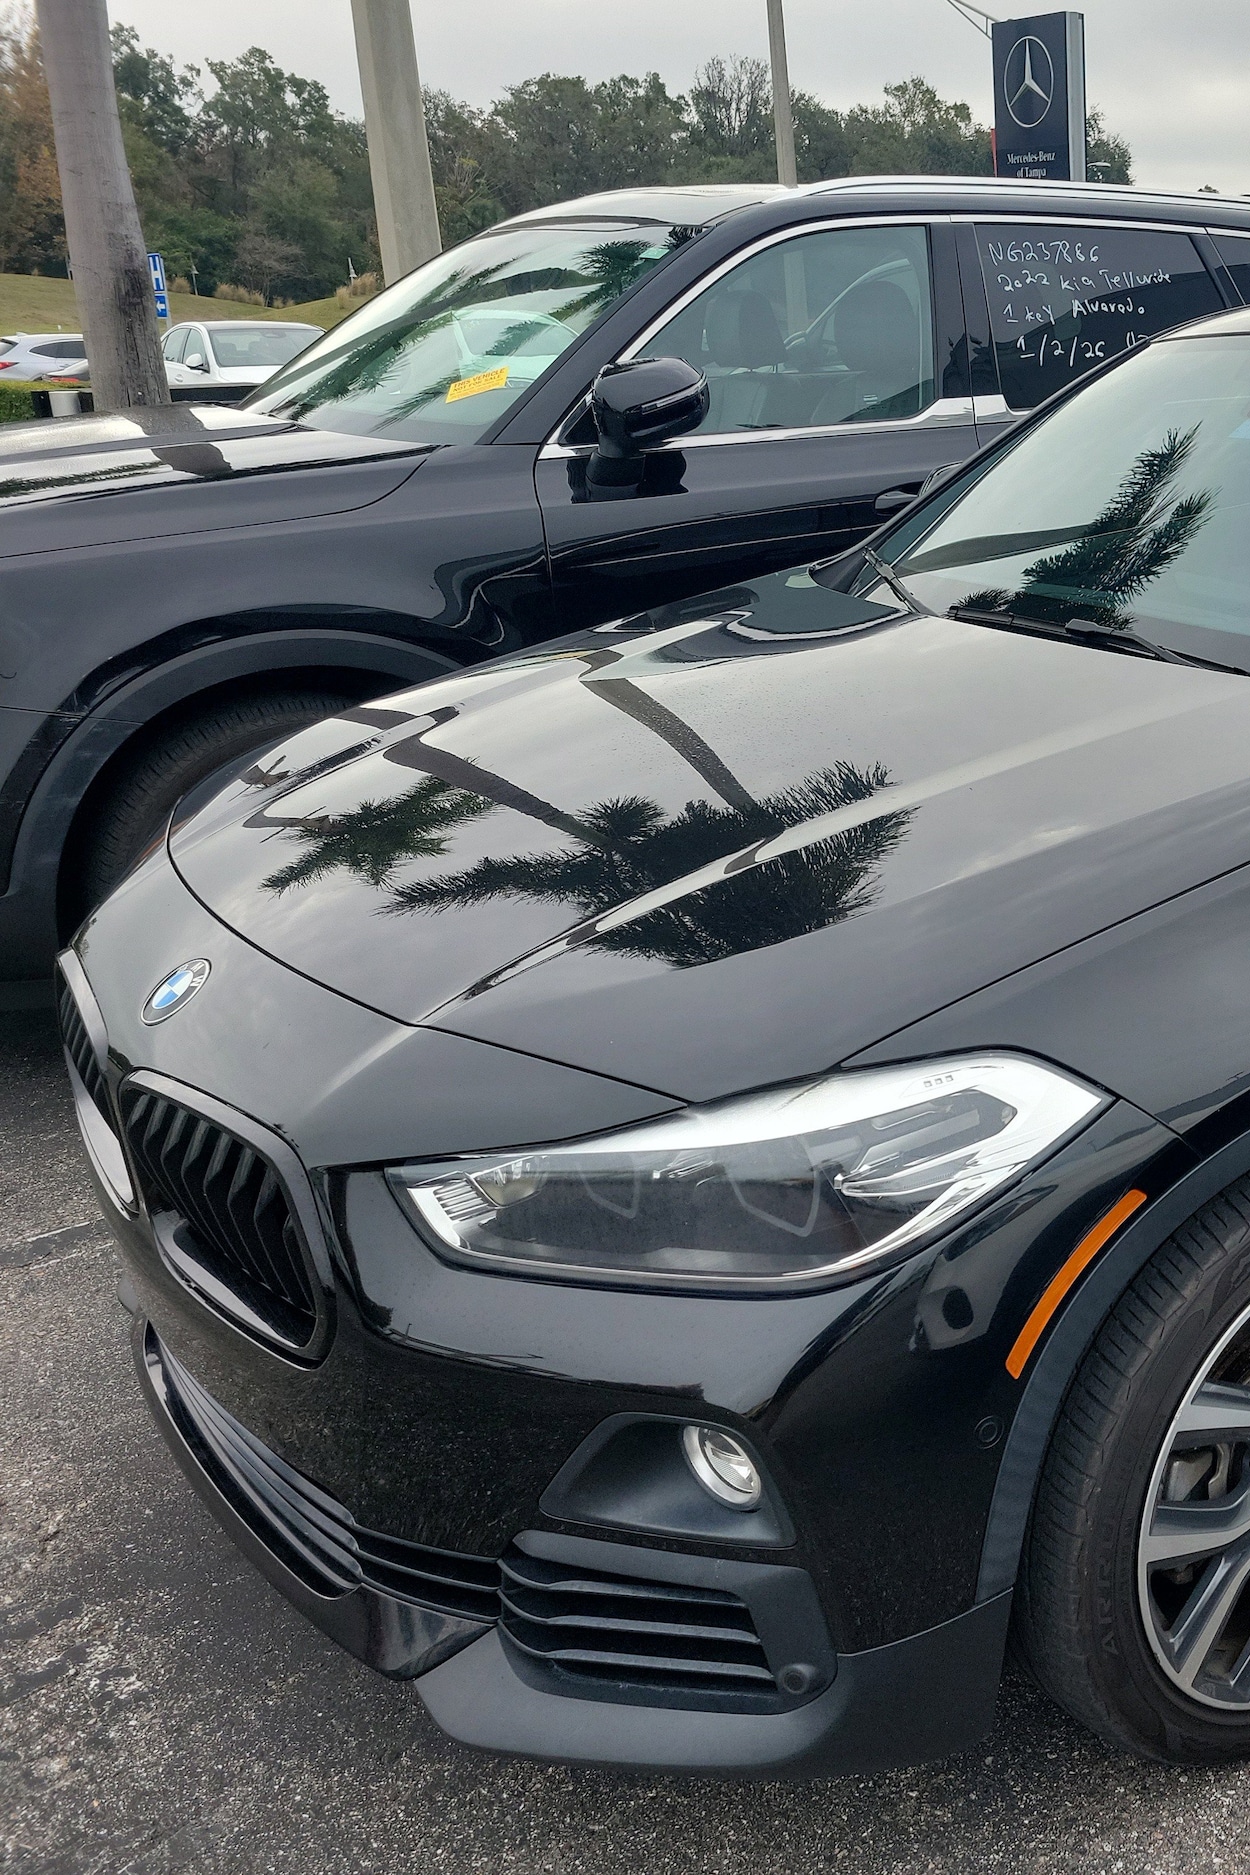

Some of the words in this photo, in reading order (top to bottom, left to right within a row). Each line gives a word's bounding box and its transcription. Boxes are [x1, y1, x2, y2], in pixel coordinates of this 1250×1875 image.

[1007, 150, 1056, 164] Mercedes-Benz
[1024, 167, 1047, 179] Tampa
[988, 240, 1099, 266] NG237886
[148, 256, 164, 291] H
[997, 269, 1051, 292] 2022
[1002, 303, 1019, 323] 1
